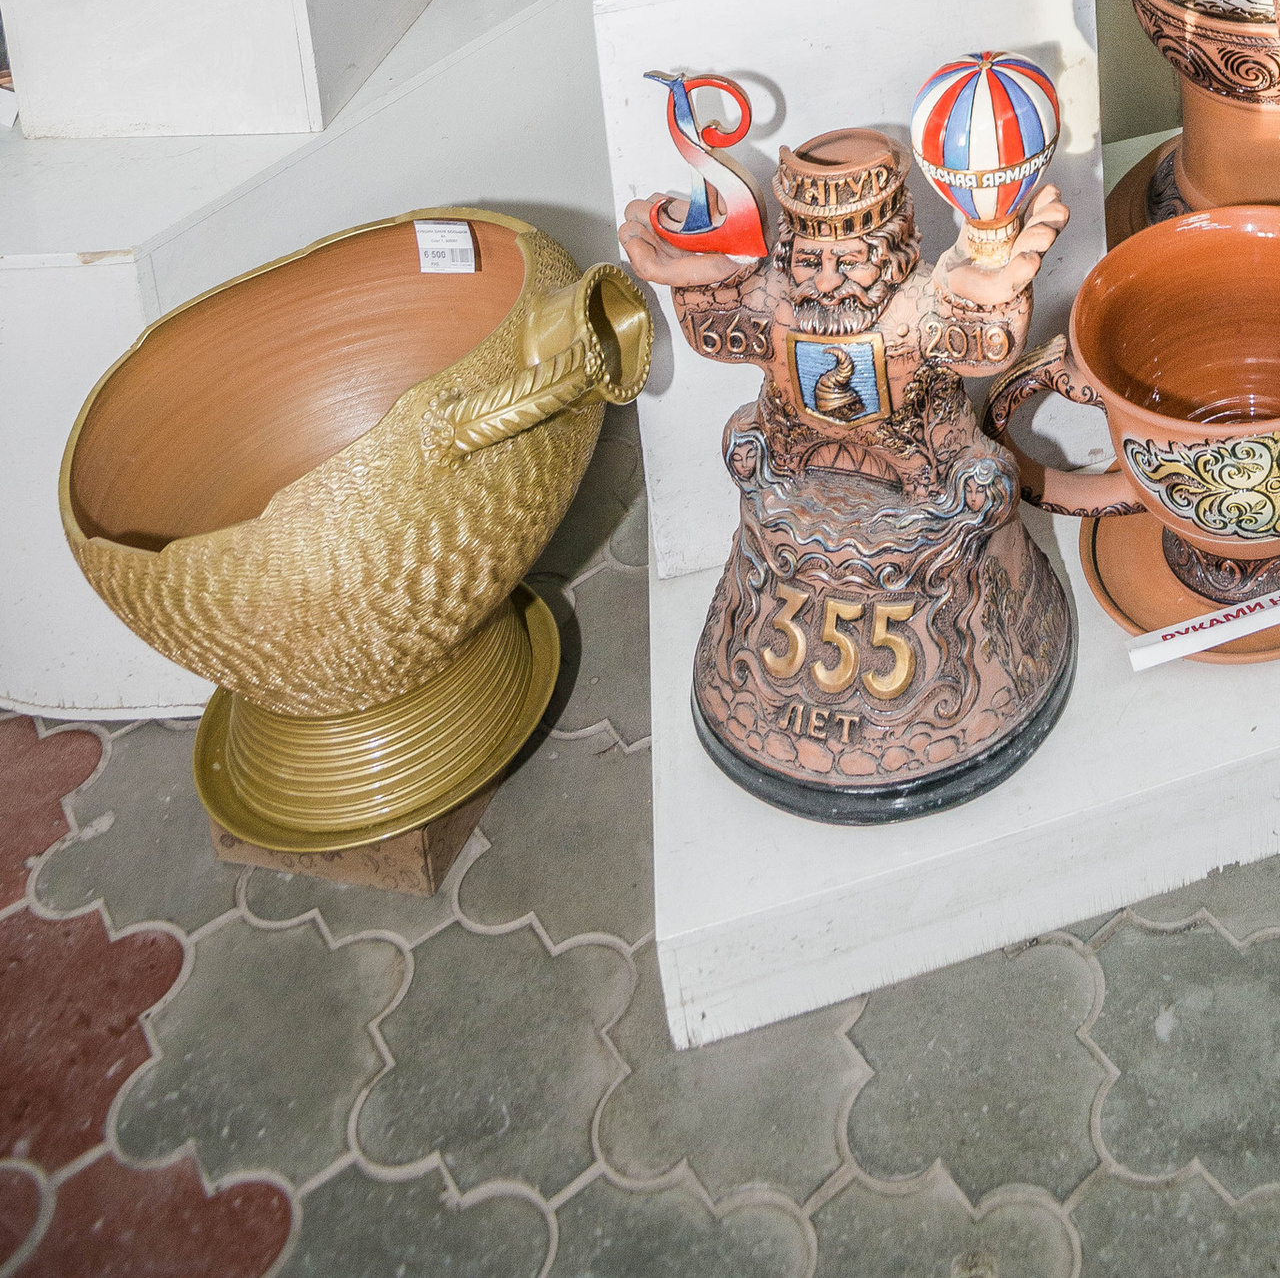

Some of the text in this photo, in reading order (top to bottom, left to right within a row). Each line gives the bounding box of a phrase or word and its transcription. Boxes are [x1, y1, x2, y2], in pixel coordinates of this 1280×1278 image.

[431, 250, 446, 259] 500
[687, 314, 770, 354] 1663
[925, 321, 1010, 361] 2019
[762, 582, 918, 700] 355
[777, 704, 860, 744] ЛЕТ
